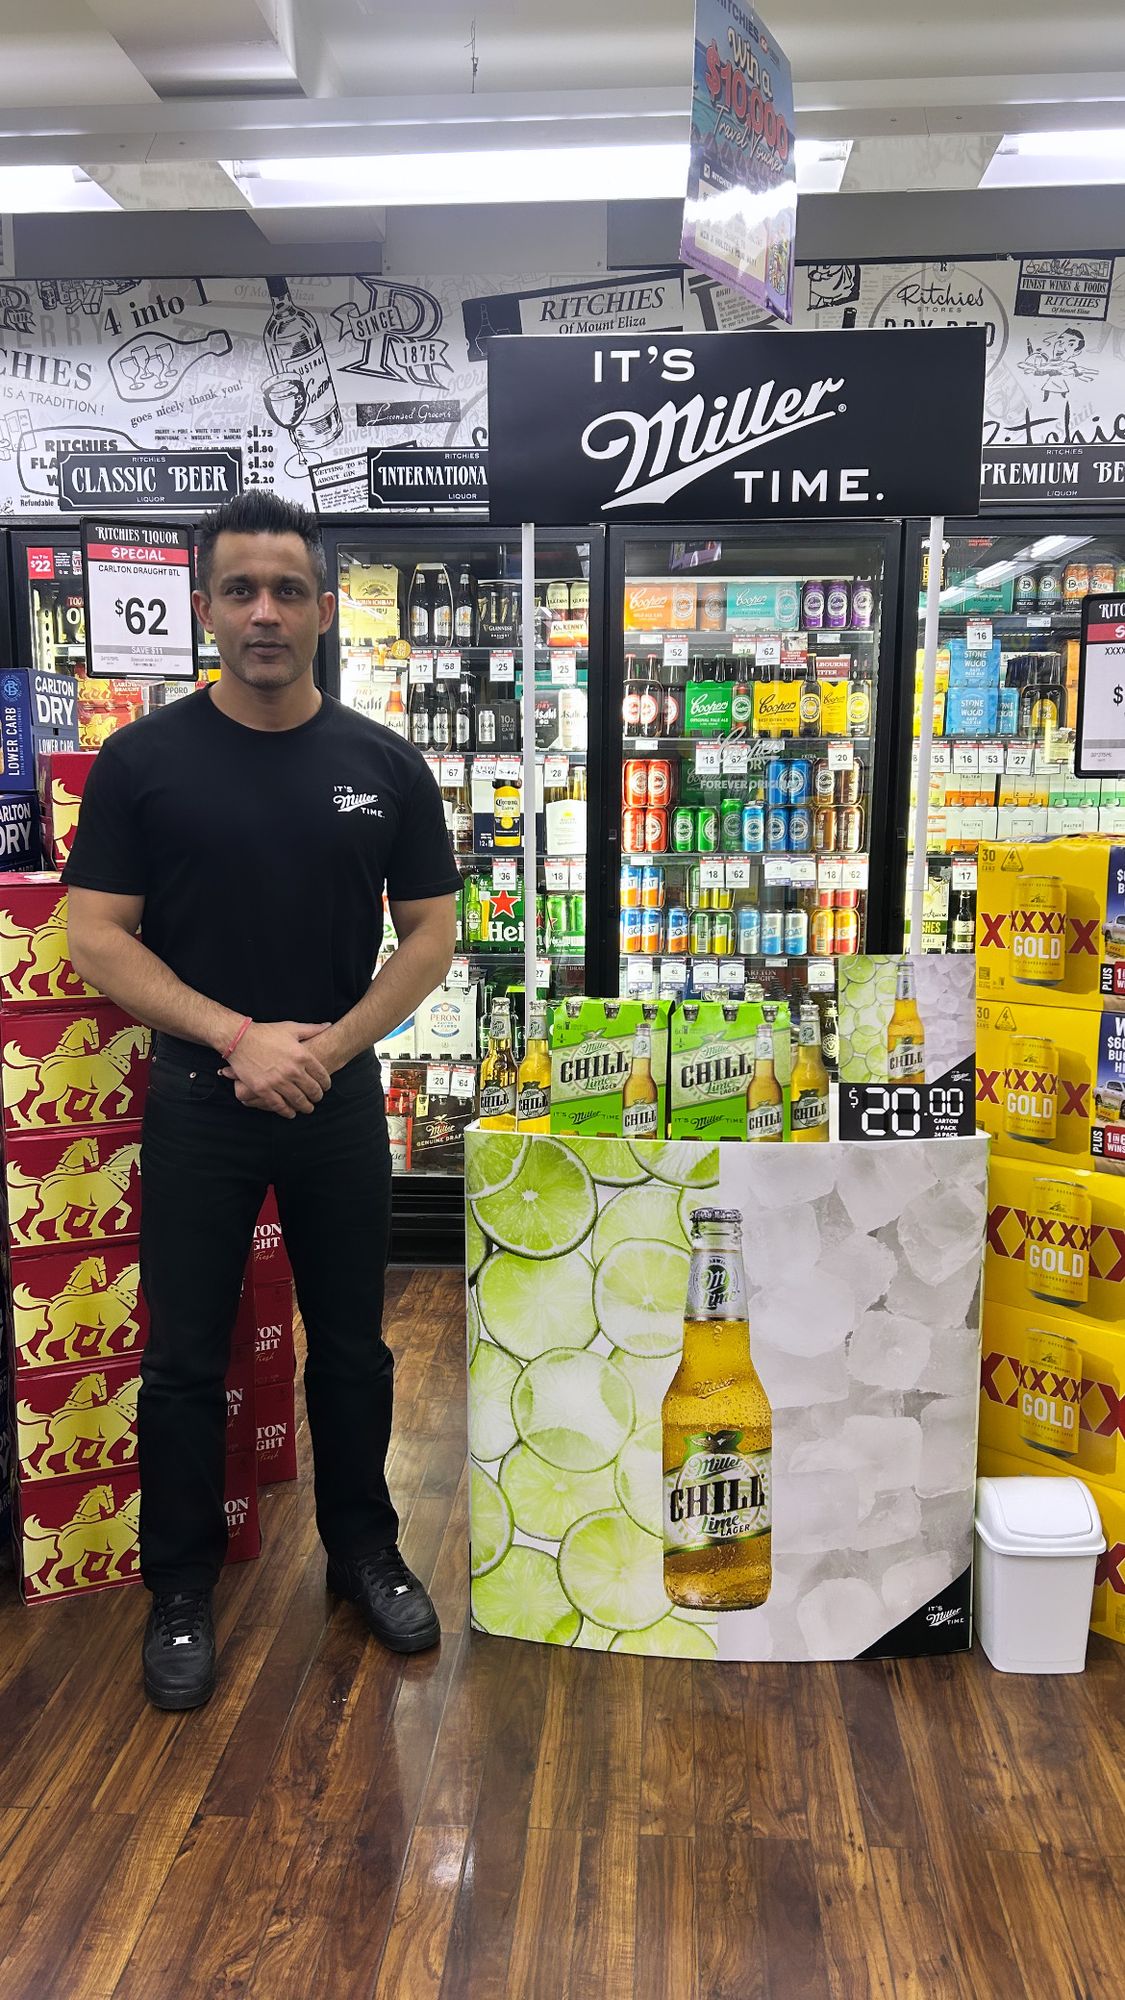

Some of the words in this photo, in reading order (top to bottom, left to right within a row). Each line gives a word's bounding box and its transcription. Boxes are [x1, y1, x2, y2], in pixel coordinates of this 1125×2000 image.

[727, 25, 760, 87] Win
[760, 68, 774, 101] a
[704, 39, 790, 166] $10,000
[715, 102, 749, 152] Travel
[897, 282, 984, 307] Ritchies
[1022, 278, 1046, 290] FINEST
[1049, 279, 1071, 291] WINES
[1074, 281, 1080, 291] &
[1083, 281, 1107, 293] FOODS
[539, 287, 665, 322] RITCHIES
[1044, 294, 1100, 308] RITCHIES
[104, 307, 122, 337] 4
[129, 294, 185, 328] into
[356, 309, 397, 339] SINCE
[559, 322, 575, 335] Of
[578, 319, 614, 334] Mount
[617, 315, 647, 329] Eliza
[401, 342, 437, 364] 1875
[594, 347, 695, 383] IT'S
[3, 387, 14, 399] IS
[16, 390, 25, 401] A
[29, 391, 97, 415] TRADITION
[130, 412, 153, 428] goes
[156, 400, 185, 418] nicely
[190, 388, 218, 406] thank
[222, 380, 245, 400] you!
[247, 425, 273, 438] $1.75
[45, 439, 118, 452] RITCHIES
[247, 441, 274, 454] $1.80
[580, 376, 846, 510] Miller
[248, 456, 274, 470] $1.30
[981, 462, 1079, 485] PREMIUM
[71, 466, 157, 493] CLASSIC
[168, 466, 229, 493] BEER
[244, 472, 275, 485] $2.20
[317, 473, 340, 485] ABOUT
[20, 499, 54, 507] Refundable
[95, 526, 140, 541] RITCHIES
[143, 530, 179, 544] LIQUOR
[111, 547, 166, 561] SPECIAL
[30, 560, 51, 572] $22
[99, 564, 132, 574] CARLTON
[133, 566, 167, 576] DRAUGHT
[115, 597, 169, 636] $62
[35, 676, 75, 696] CARLTON
[36, 694, 74, 726] DRY
[691, 694, 728, 715] Coopers
[759, 694, 796, 716] Coopers
[4, 707, 18, 739] CARB
[6, 740, 20, 776] LOWER
[333, 785, 353, 793] IT'S
[333, 793, 378, 812] Miller
[982, 850, 996, 862] 30
[1010, 910, 1066, 935] XXXX
[1013, 935, 1061, 959] GOLD
[1102, 967, 1112, 990] PLUS
[430, 1014, 461, 1022] PERONI
[977, 1007, 990, 1019] 30
[583, 1042, 610, 1055] Miller
[702, 1045, 730, 1058] Miller
[560, 1051, 629, 1083] CHILL
[681, 1052, 754, 1088] CHILL
[889, 1049, 923, 1070] CHILL
[584, 1076, 610, 1090] Lime
[706, 1079, 733, 1095] Lime
[1004, 1068, 1058, 1095] XXXX
[481, 1094, 509, 1108] CHILL
[519, 1095, 548, 1111] CHILL
[1007, 1092, 1053, 1118] GOLD
[568, 1111, 601, 1125] Miller
[624, 1110, 657, 1127] CHILL
[690, 1114, 725, 1130] Miller
[749, 1111, 782, 1130] CHILL
[794, 1104, 826, 1121] CHILL
[849, 1087, 963, 1137] $20.00
[416, 1137, 444, 1148] GENUINE
[1093, 1130, 1103, 1153] PLUS
[1026, 1215, 1089, 1252] XXXX
[1029, 1245, 1084, 1278] GOLD
[1019, 1364, 1080, 1404] XXXX
[1023, 1393, 1075, 1429] GOLD
[688, 1457, 742, 1481] Miller
[669, 1474, 766, 1523] CHILL
[697, 1513, 740, 1536] Lime
[720, 1523, 750, 1536] LAGER
[926, 1607, 962, 1627] Miller
